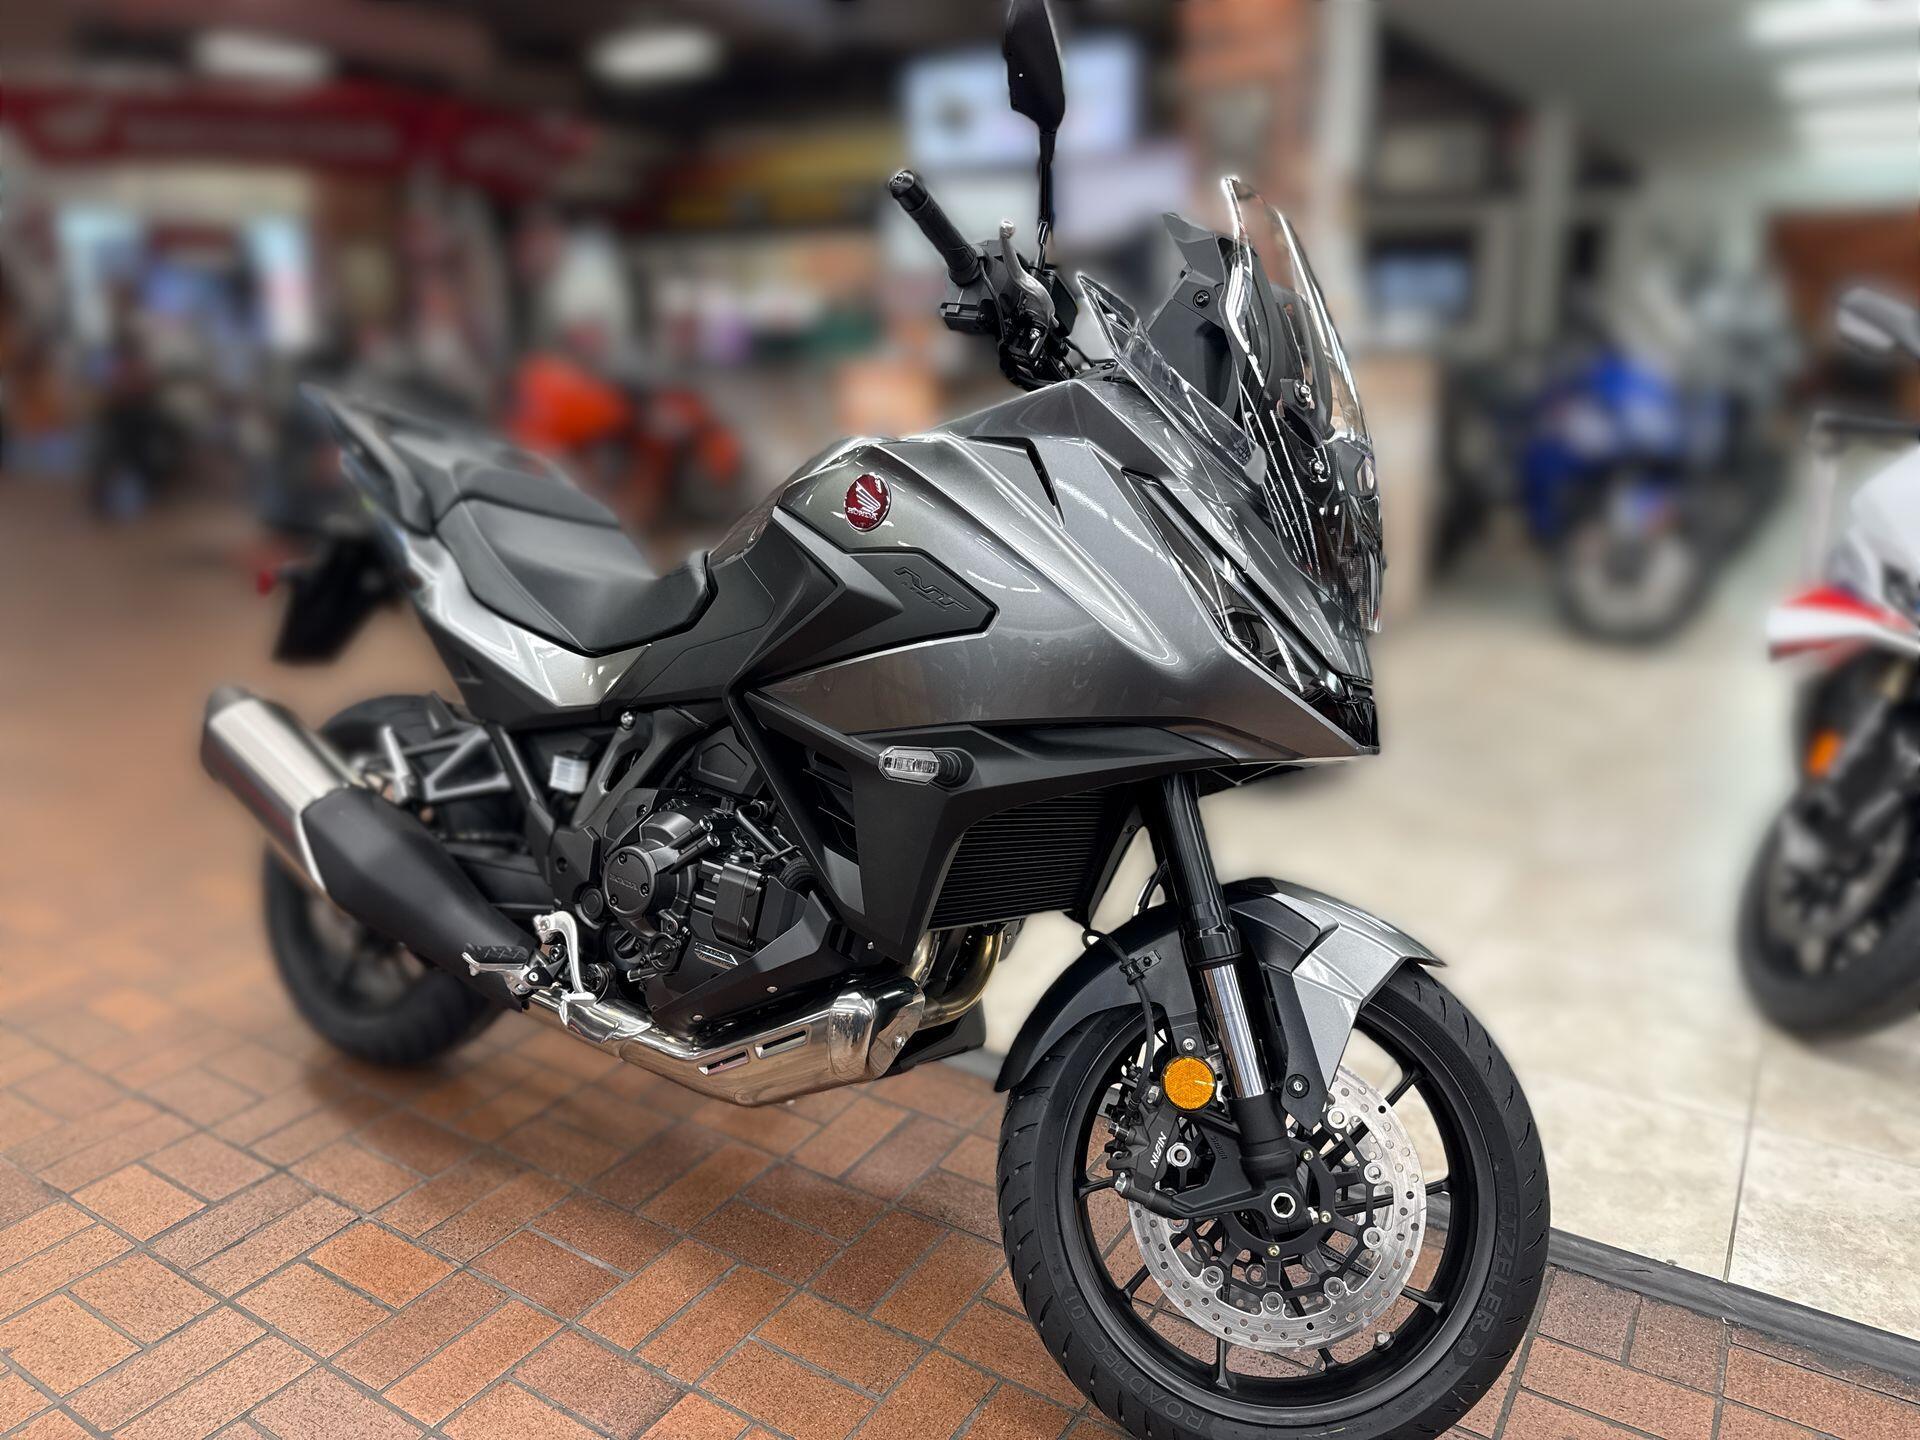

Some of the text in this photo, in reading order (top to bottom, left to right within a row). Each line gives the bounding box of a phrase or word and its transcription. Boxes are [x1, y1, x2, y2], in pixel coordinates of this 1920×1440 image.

[847, 506, 878, 520] HONDA
[1150, 1131, 1167, 1168] NISSIN
[1466, 1177, 1518, 1333] METZELER
[1064, 1294, 1205, 1430] ROADTEC 01
